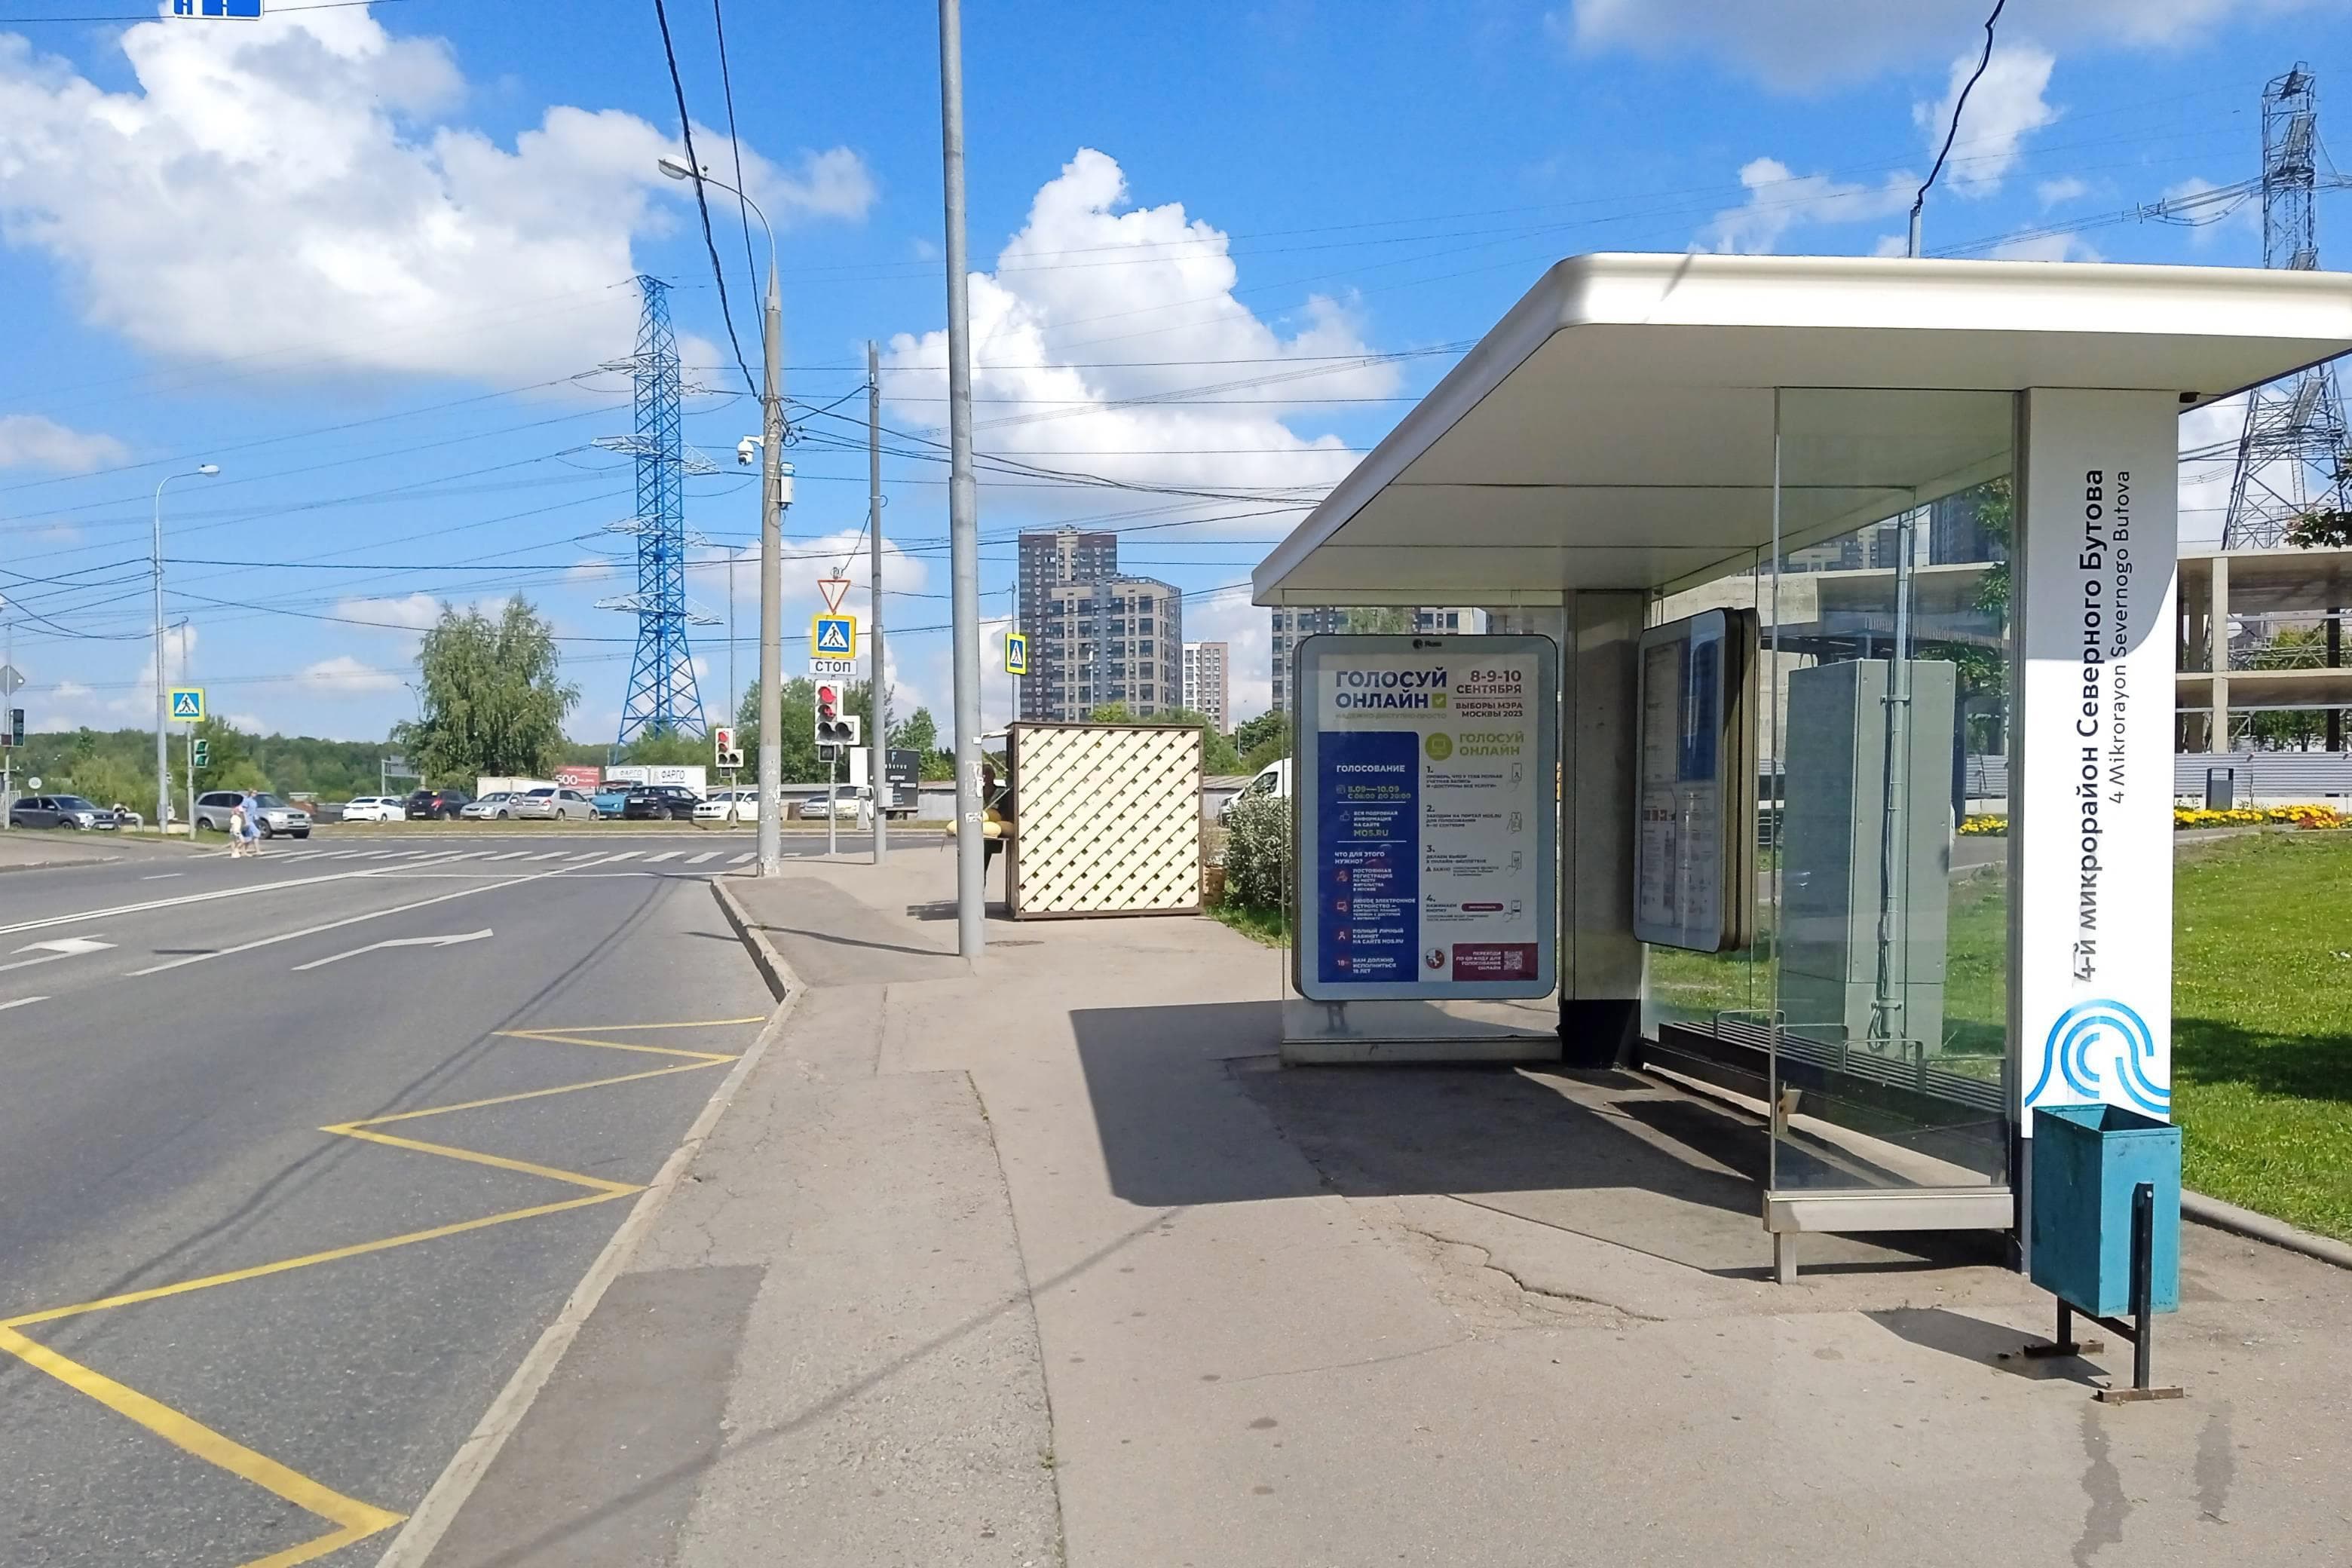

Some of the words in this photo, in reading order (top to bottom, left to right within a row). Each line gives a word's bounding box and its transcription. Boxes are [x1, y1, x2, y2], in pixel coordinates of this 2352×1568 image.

[2112, 471, 2130, 541] Butova
[2079, 470, 2107, 569] Бутова
[2111, 548, 2133, 657] Severnogo
[815, 661, 850, 672] СТОП
[2077, 580, 2105, 737] Северного
[1336, 666, 1447, 688] ГОЛОСУЙ
[1470, 670, 1521, 682] 8-9-10
[1456, 684, 1521, 694] СЕНТЯБРЯ
[1335, 689, 1429, 709] ОНЛАЙН
[2109, 665, 2130, 786] Mikrorayon
[1459, 730, 1524, 743] ГОЛОСУЙ
[1459, 745, 1520, 755] ОНЛАЙН
[555, 774, 578, 786] 500
[661, 770, 685, 779] ФАРГО
[2109, 792, 2124, 804] 4
[2075, 747, 2102, 930] микрорайон
[1426, 894, 1436, 902] 4.
[2073, 940, 2096, 982] 4-й
